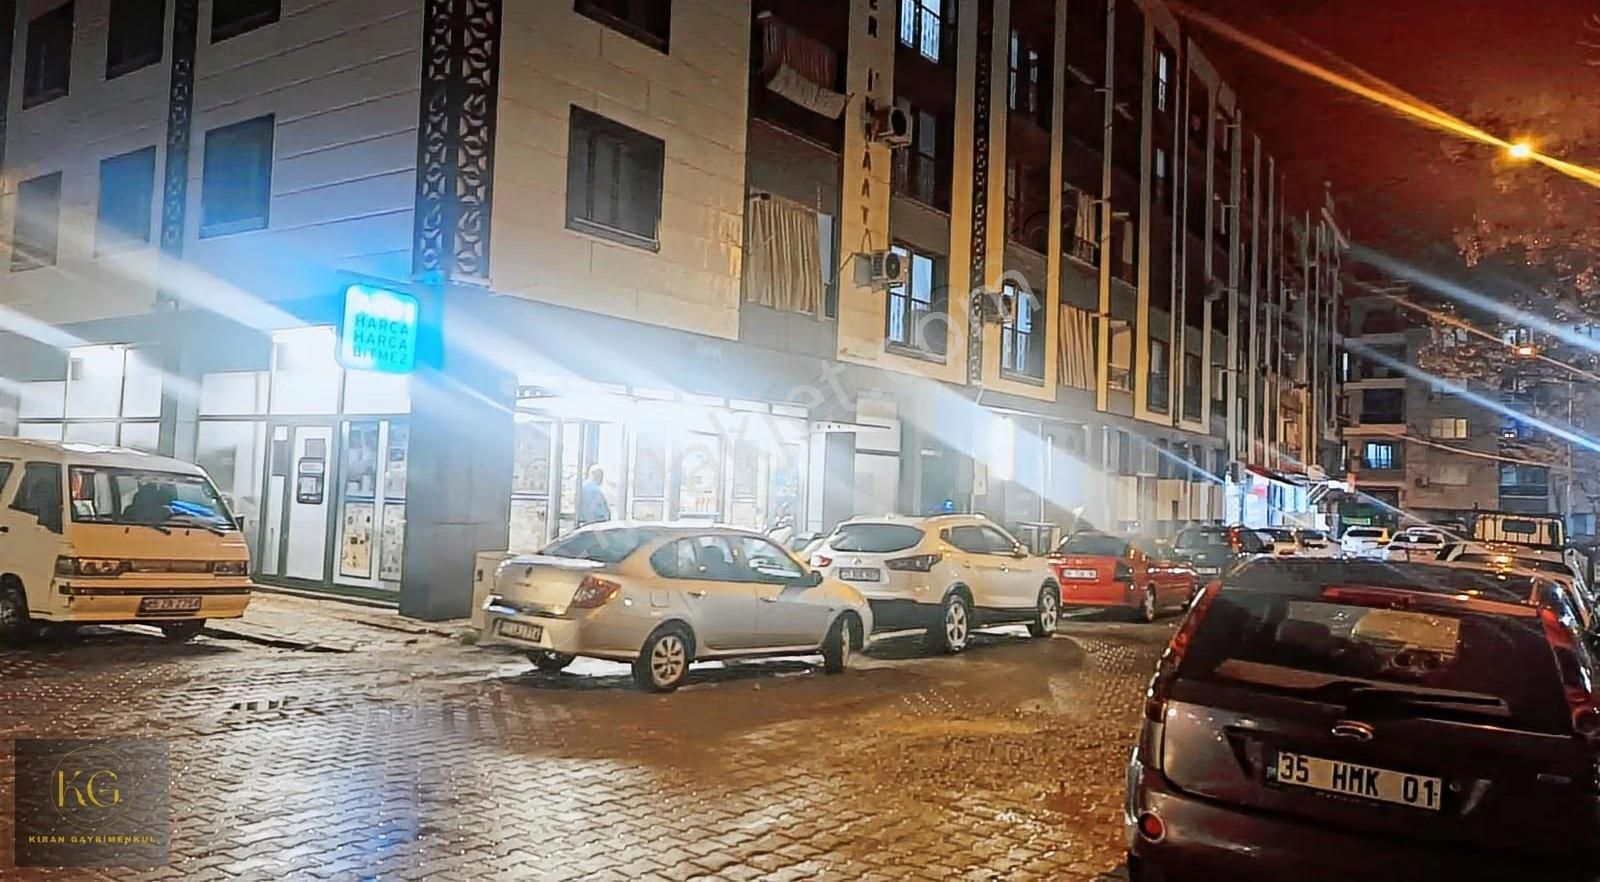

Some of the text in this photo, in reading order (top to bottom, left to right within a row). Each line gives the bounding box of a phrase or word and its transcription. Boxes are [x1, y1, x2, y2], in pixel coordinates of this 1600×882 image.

[355, 313, 409, 335] HARCA
[354, 330, 408, 350] HARCA
[1280, 755, 1434, 807] 35 HMK 01
